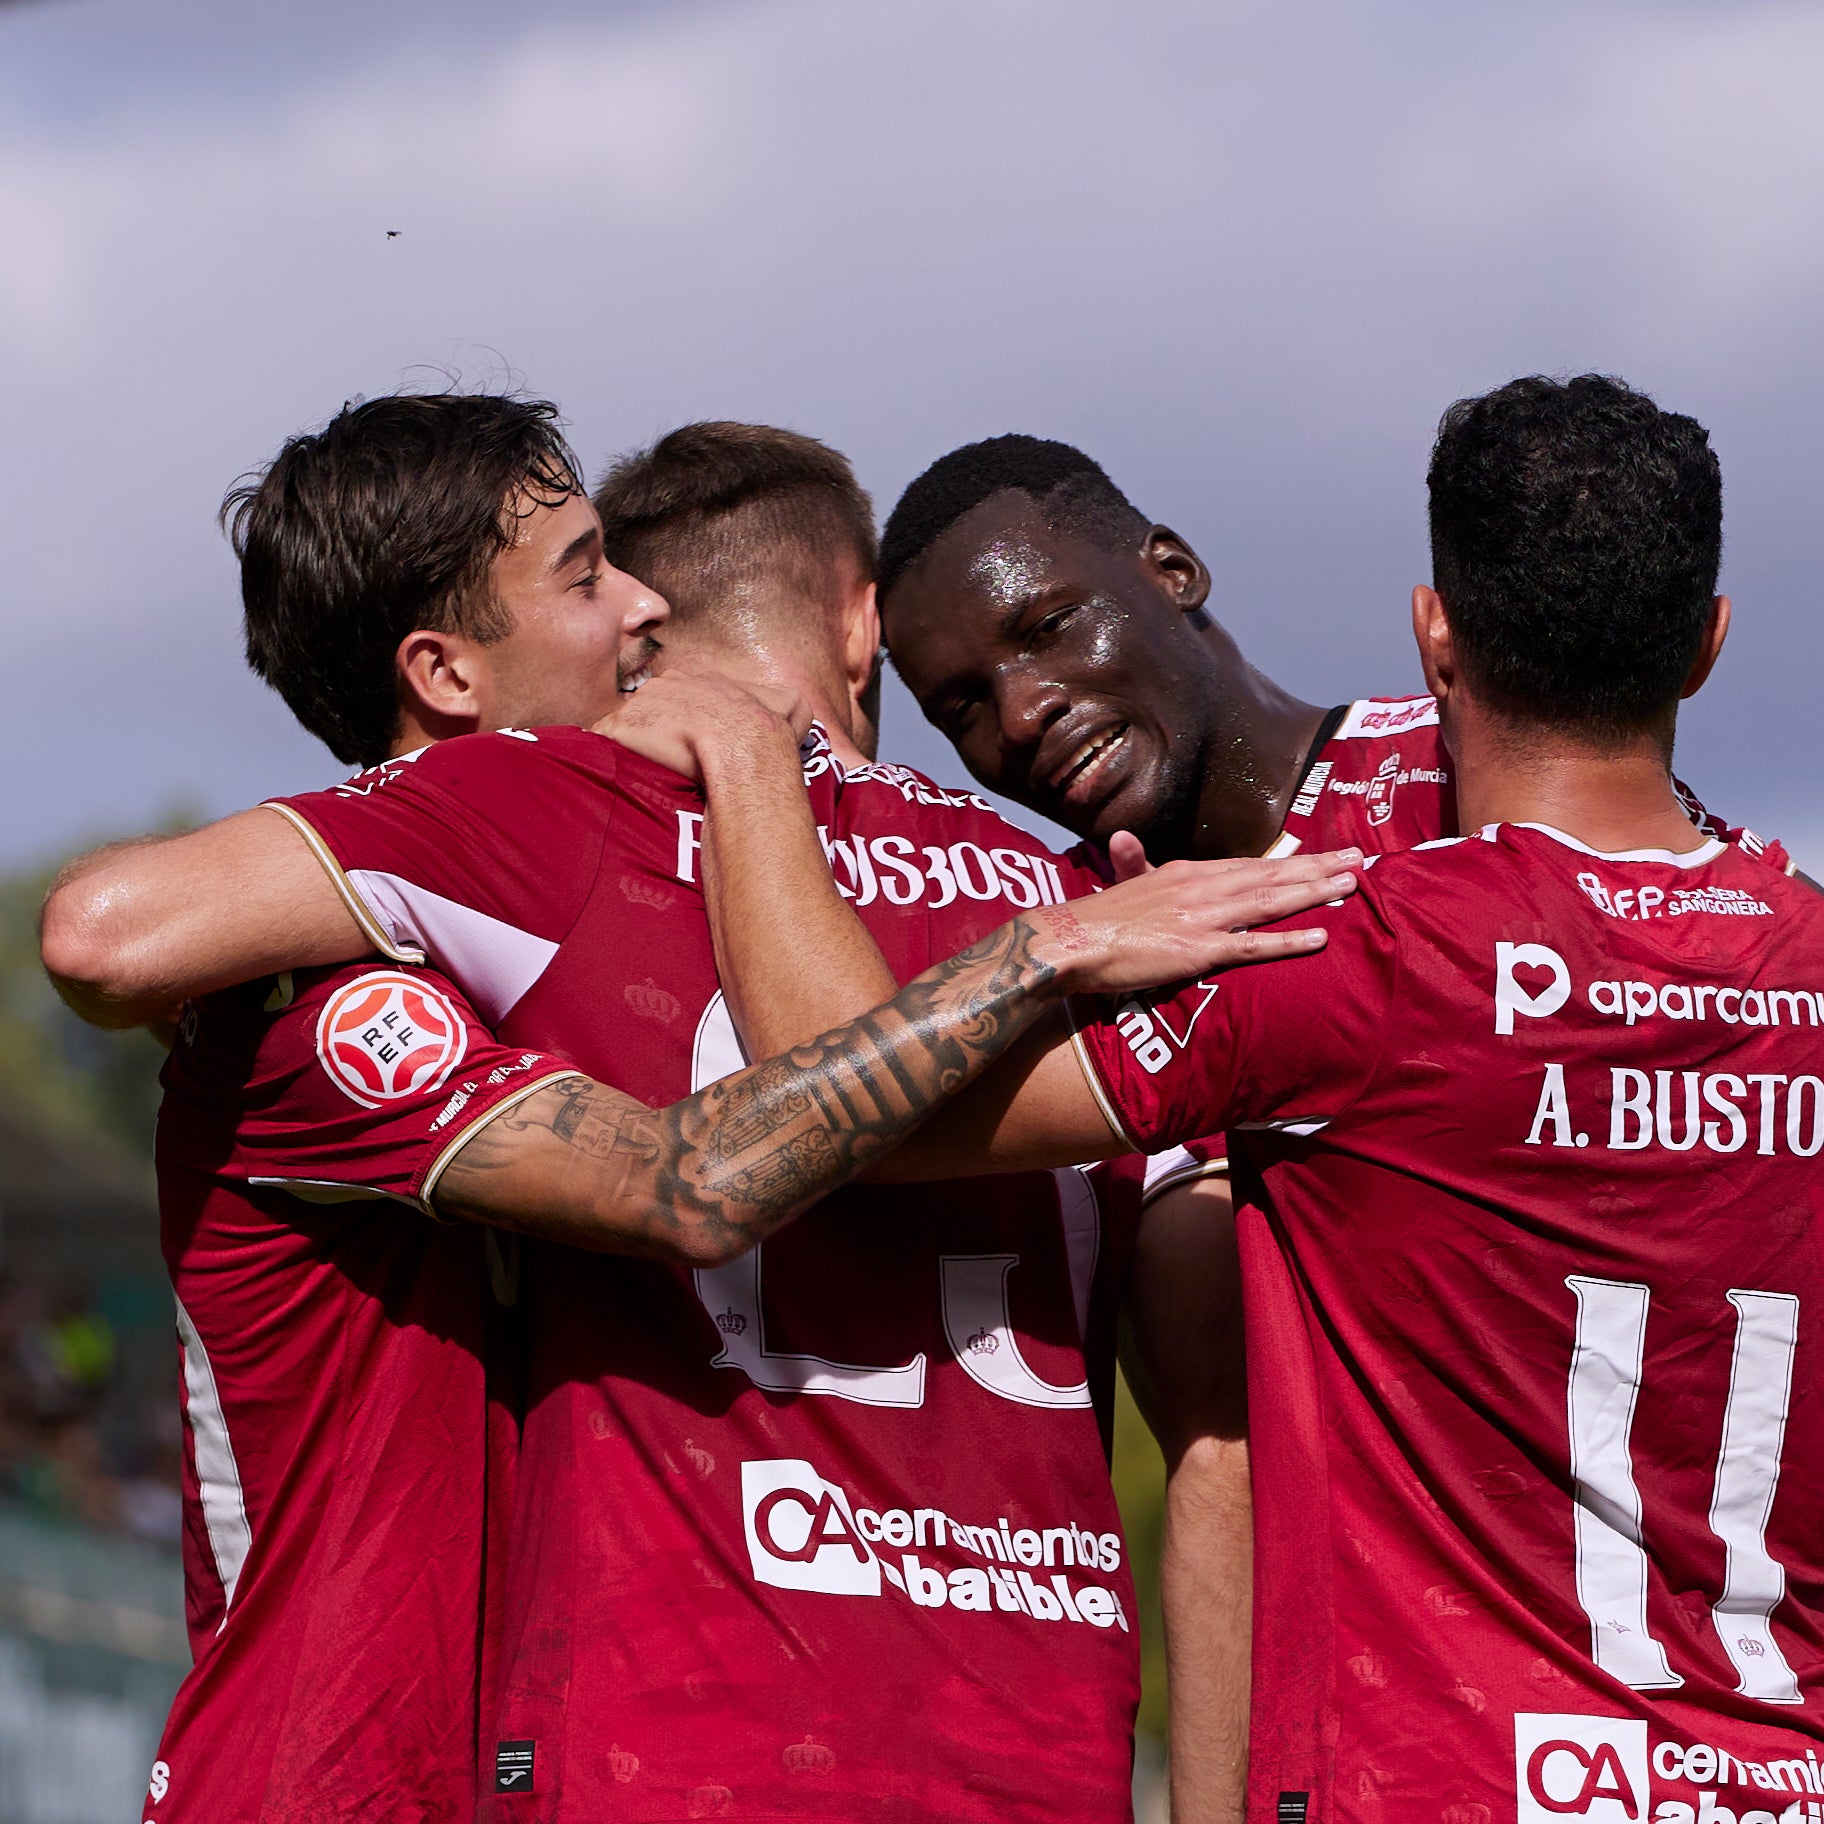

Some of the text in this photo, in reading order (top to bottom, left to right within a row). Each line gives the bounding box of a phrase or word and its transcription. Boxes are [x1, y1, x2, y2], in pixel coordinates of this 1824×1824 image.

[1668, 899, 1775, 916] SANGONERA
[1524, 1063, 1589, 1148] A.
[1564, 1275, 1805, 1705] 11
[855, 1508, 1121, 1573] cerramientos
[1526, 1739, 1639, 1821] CA
